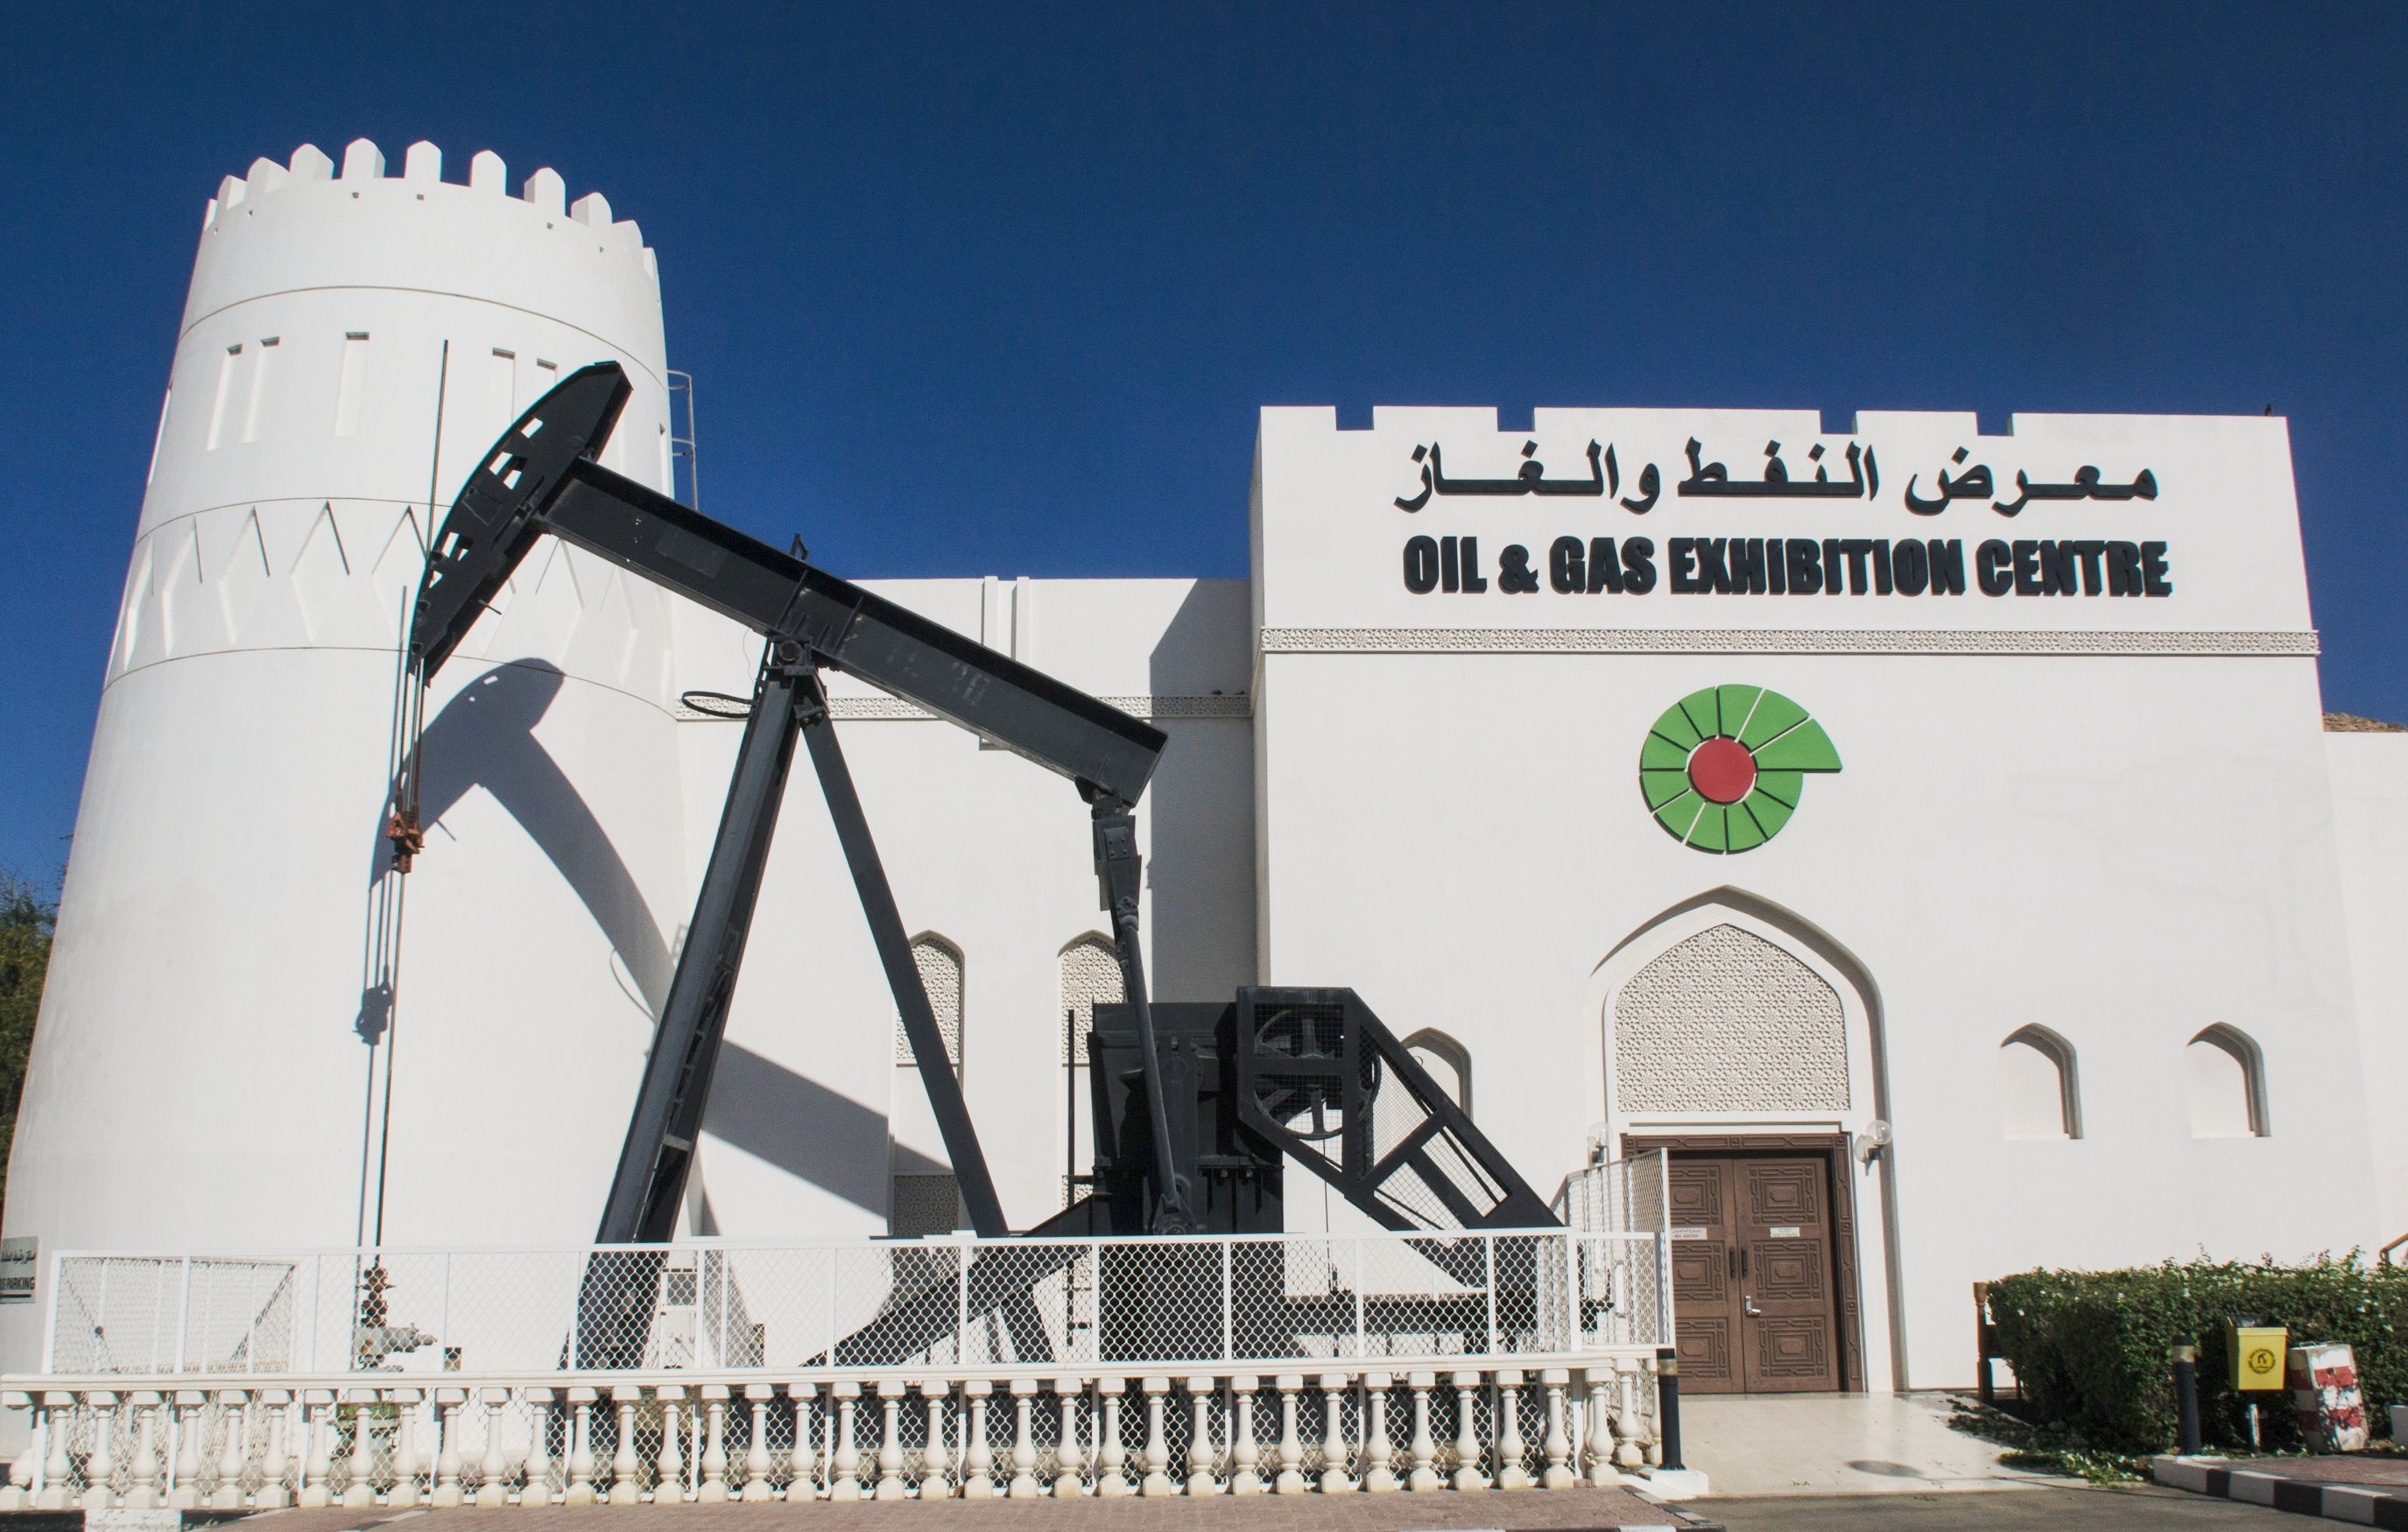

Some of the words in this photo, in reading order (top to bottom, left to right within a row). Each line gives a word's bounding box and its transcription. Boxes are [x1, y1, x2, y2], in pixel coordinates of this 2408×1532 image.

[1393, 439, 1660, 515] والغاز
[1677, 436, 1879, 501] النفط
[1905, 446, 2158, 518] معرض
[1403, 535, 1488, 594] OIL
[1497, 544, 1539, 594] &
[1549, 536, 1657, 595] GAS
[1667, 537, 1966, 597] EXHIBITION
[1975, 538, 2172, 598] CENTRE
[7, 1276, 36, 1290] PARKING
